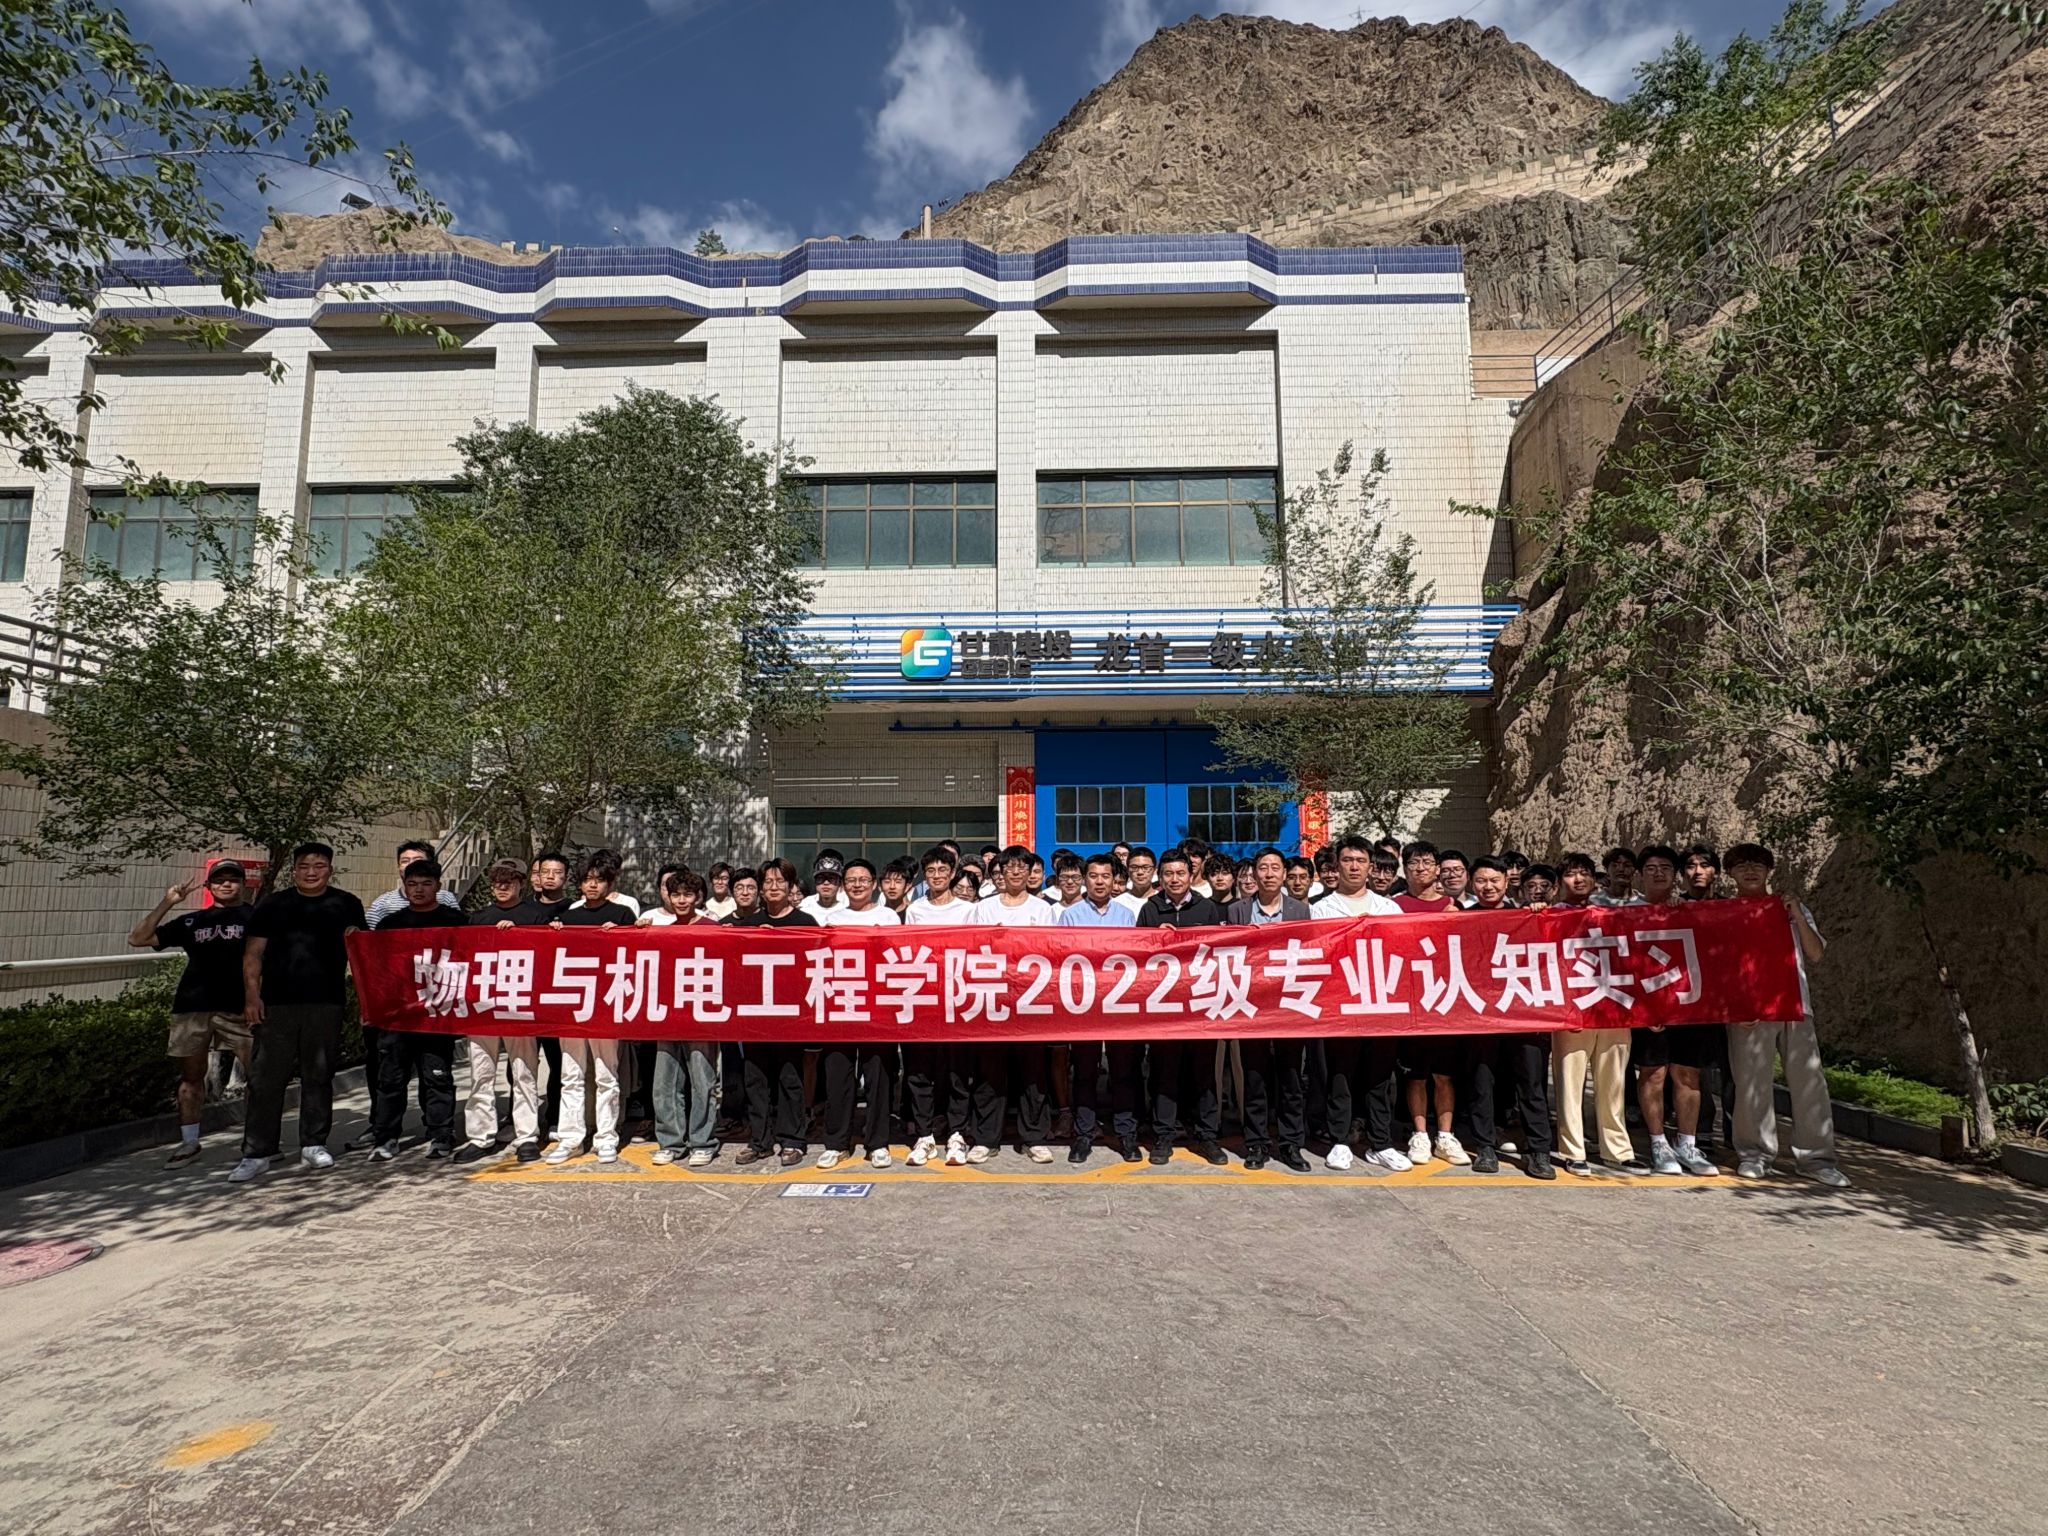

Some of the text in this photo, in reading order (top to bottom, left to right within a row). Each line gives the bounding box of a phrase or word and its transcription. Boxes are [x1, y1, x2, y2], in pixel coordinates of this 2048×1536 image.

[958, 630, 1072, 659] 甘肃电投
[961, 658, 1032, 678] GEPIC
[413, 928, 1701, 1024] 物理与机电工程学院2022级专业认知实习
